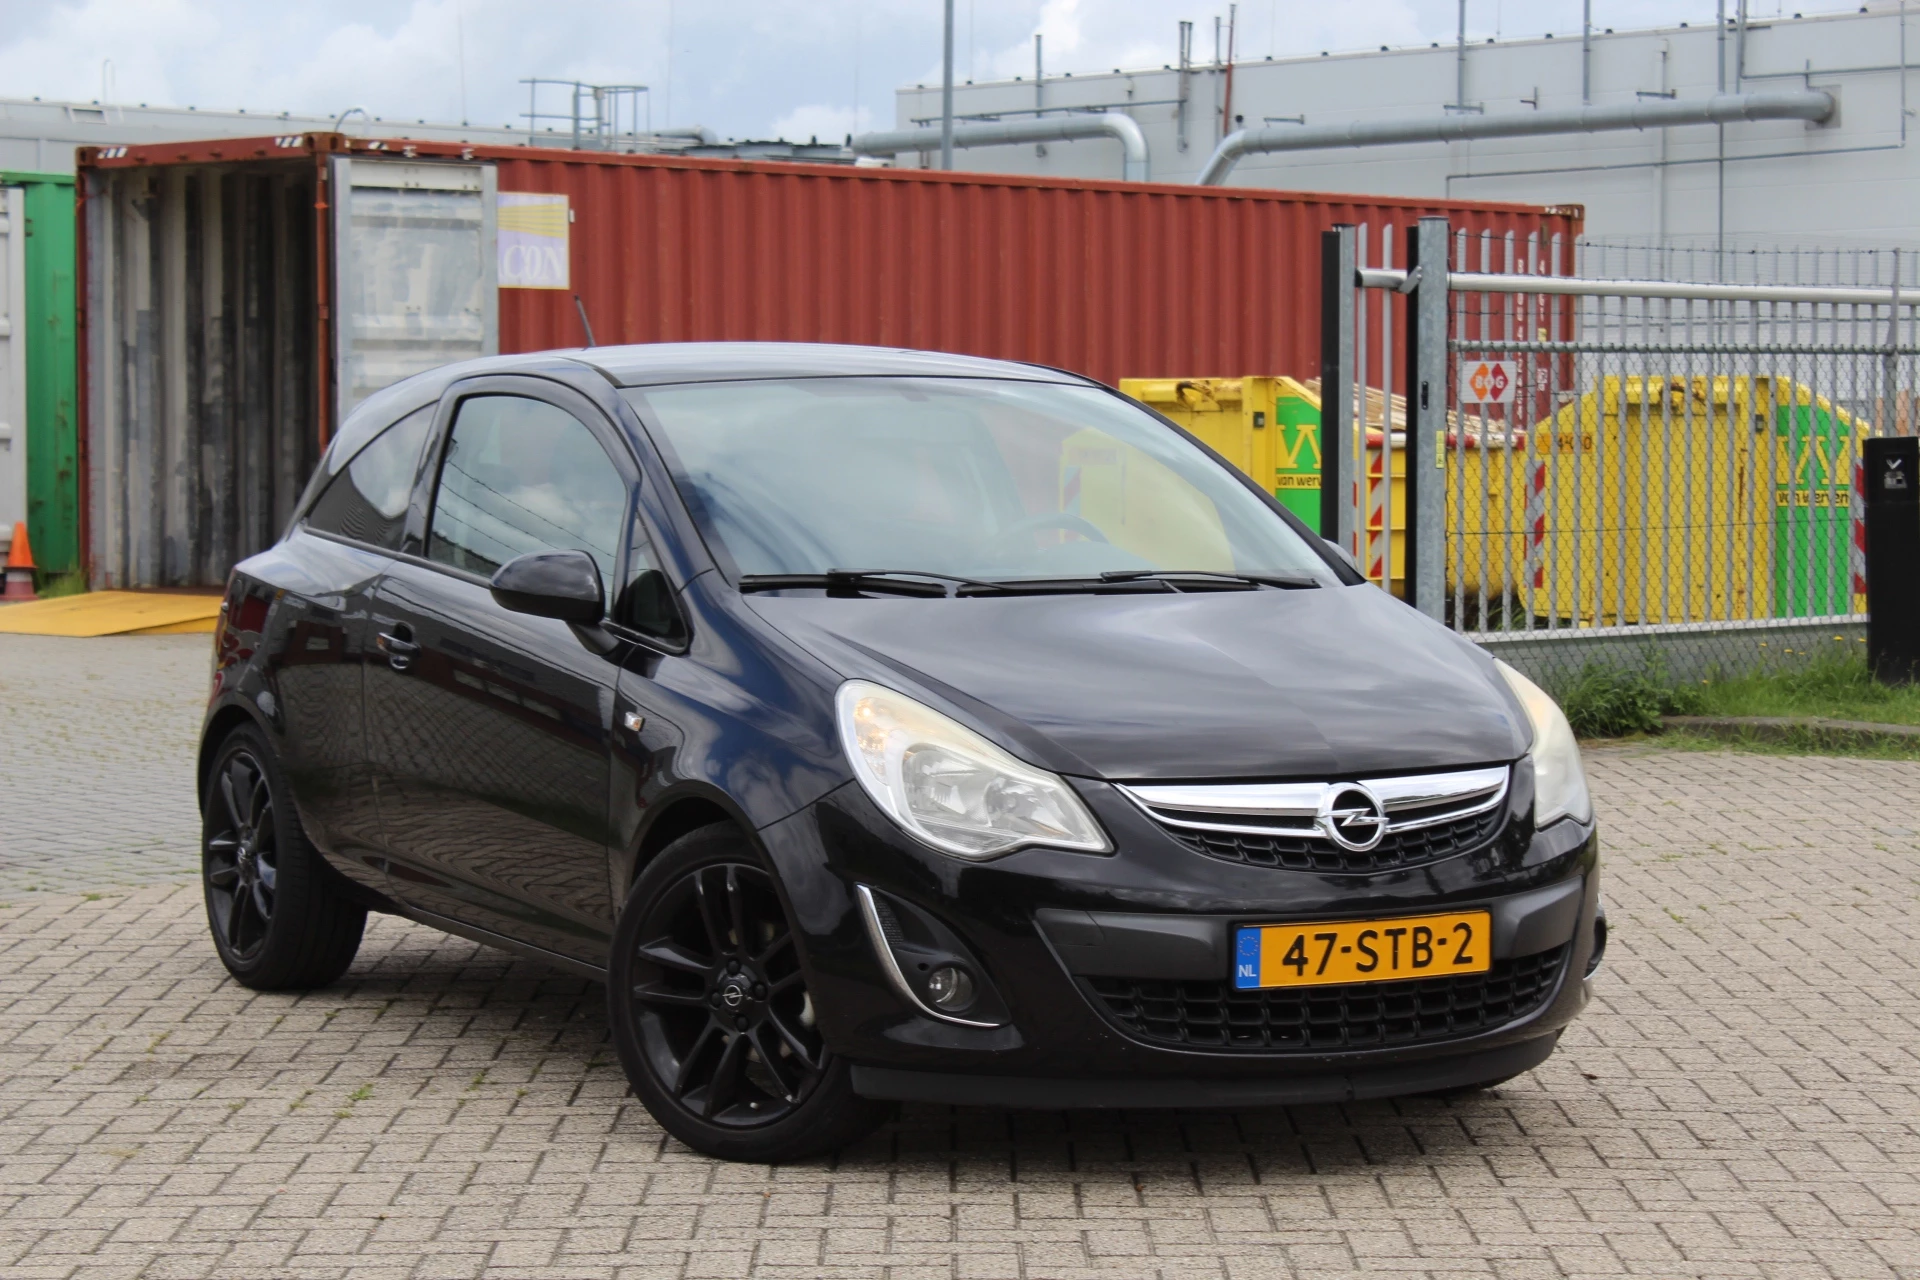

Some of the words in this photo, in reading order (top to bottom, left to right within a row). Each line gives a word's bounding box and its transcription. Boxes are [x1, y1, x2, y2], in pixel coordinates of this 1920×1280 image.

[499, 244, 566, 280] CON
[1282, 922, 1473, 976] 47-STB-2
[1238, 965, 1256, 977] NL
